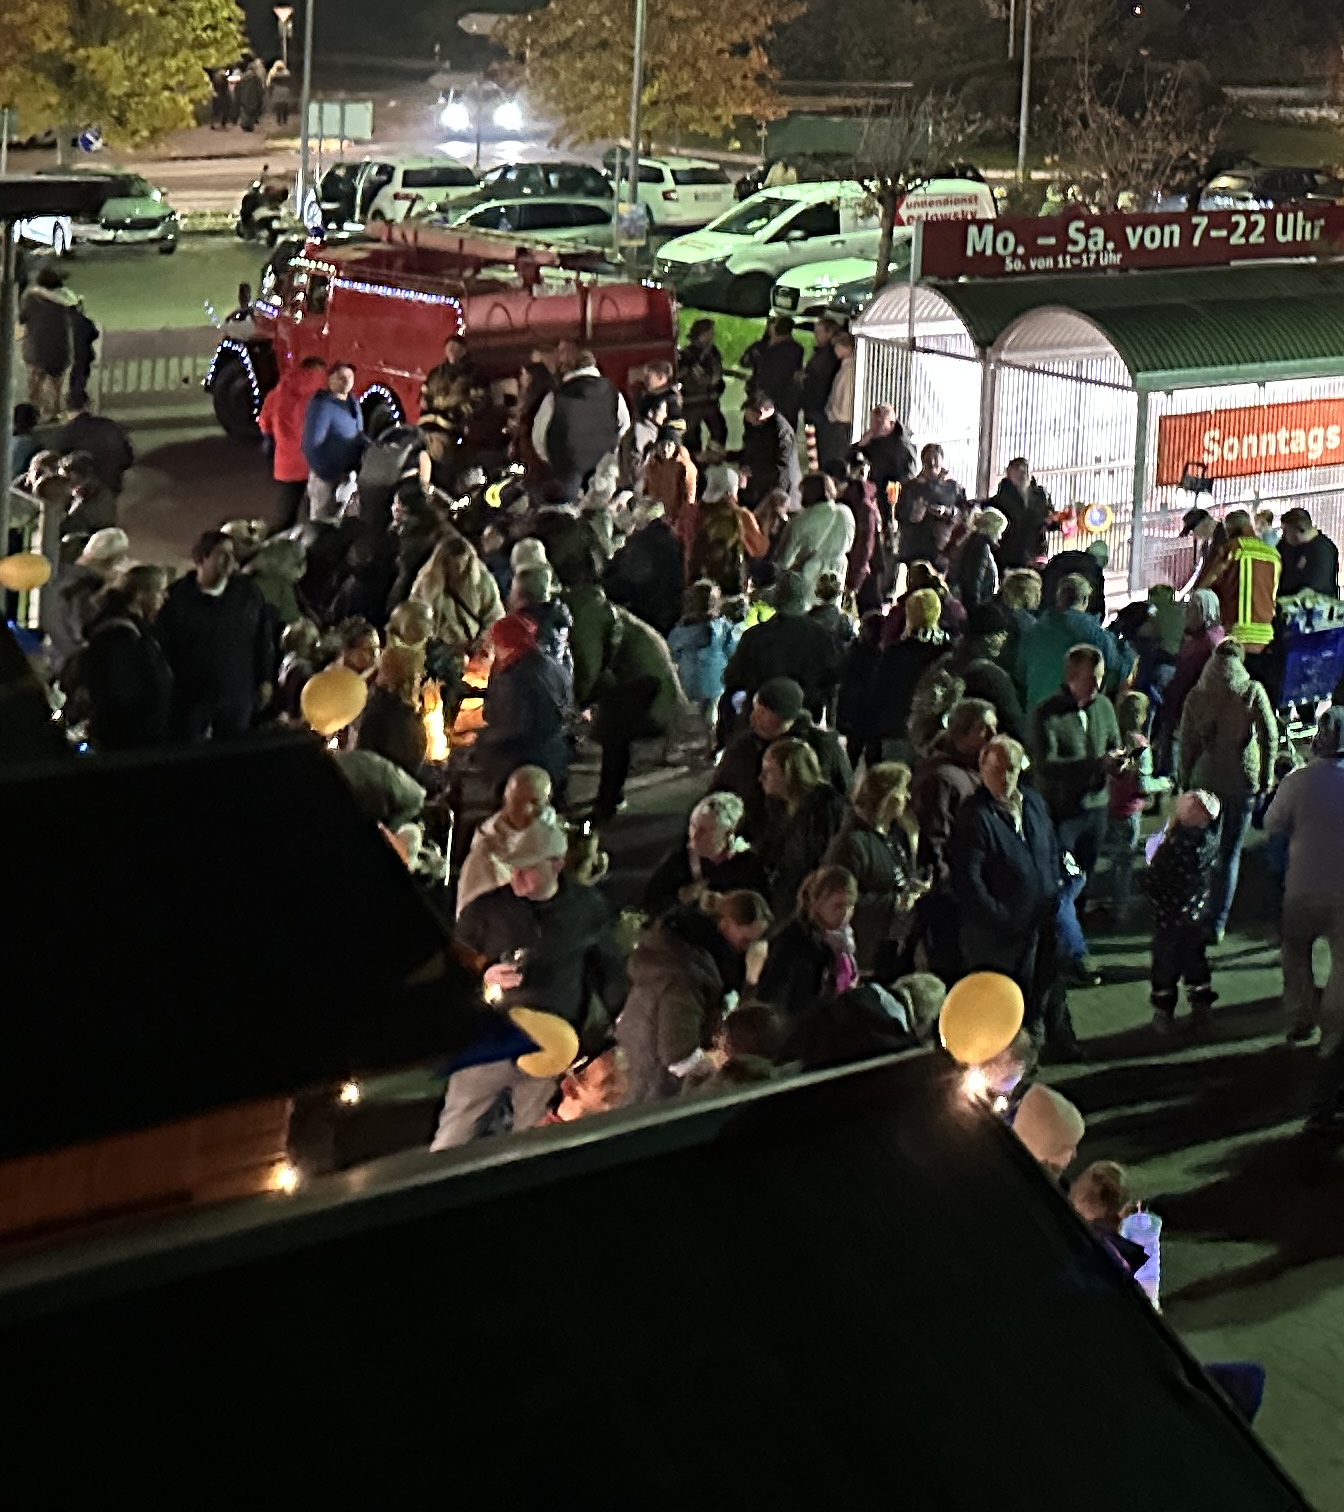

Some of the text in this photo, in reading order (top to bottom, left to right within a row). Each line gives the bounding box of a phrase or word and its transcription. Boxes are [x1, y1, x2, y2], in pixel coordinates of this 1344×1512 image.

[966, 223, 1025, 257] Mo.
[1066, 219, 1115, 252] Sa.
[1125, 223, 1180, 250] von
[1275, 211, 1325, 243] Uhr
[1029, 255, 1053, 270] von
[1100, 249, 1123, 266] Uhr
[1203, 426, 1340, 465] Sonntags
